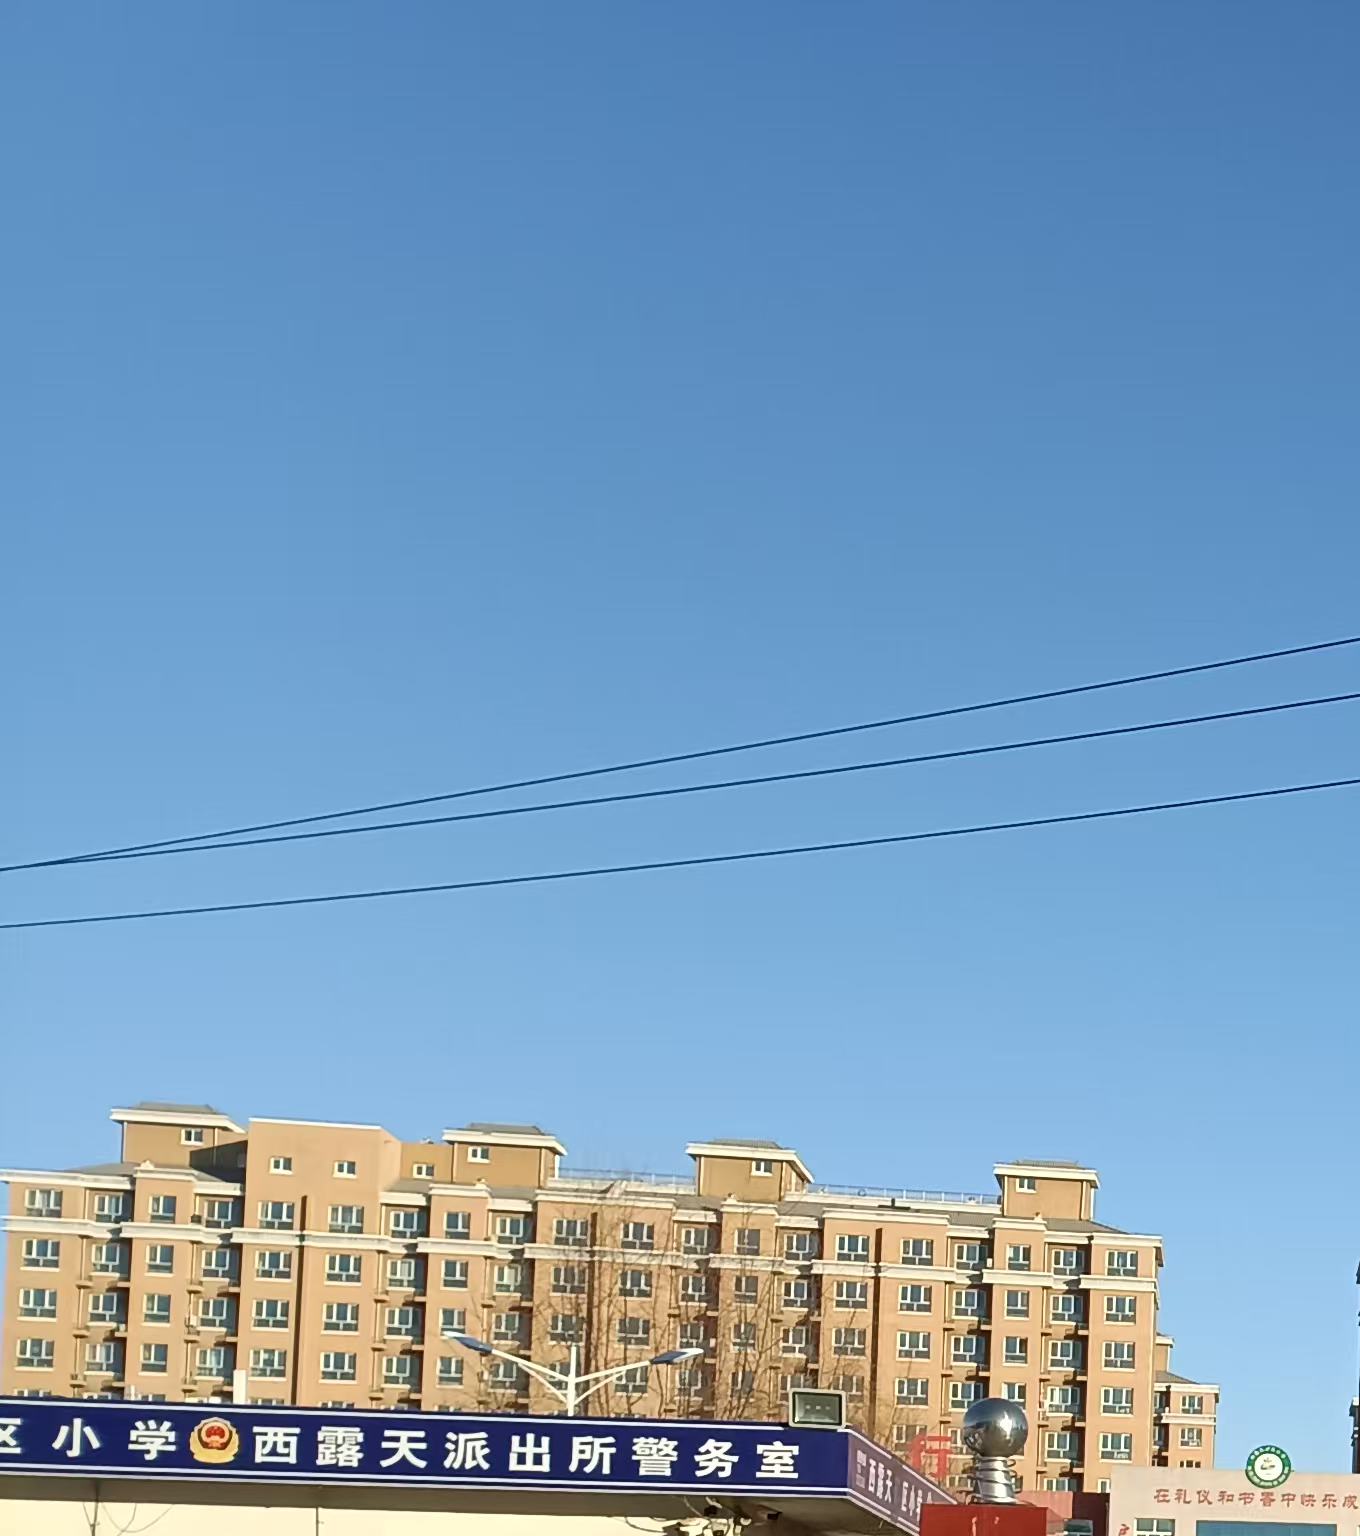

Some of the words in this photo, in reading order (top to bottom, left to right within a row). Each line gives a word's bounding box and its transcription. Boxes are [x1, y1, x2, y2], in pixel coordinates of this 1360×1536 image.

[252, 1425, 800, 1479] 西露天派出所警务室
